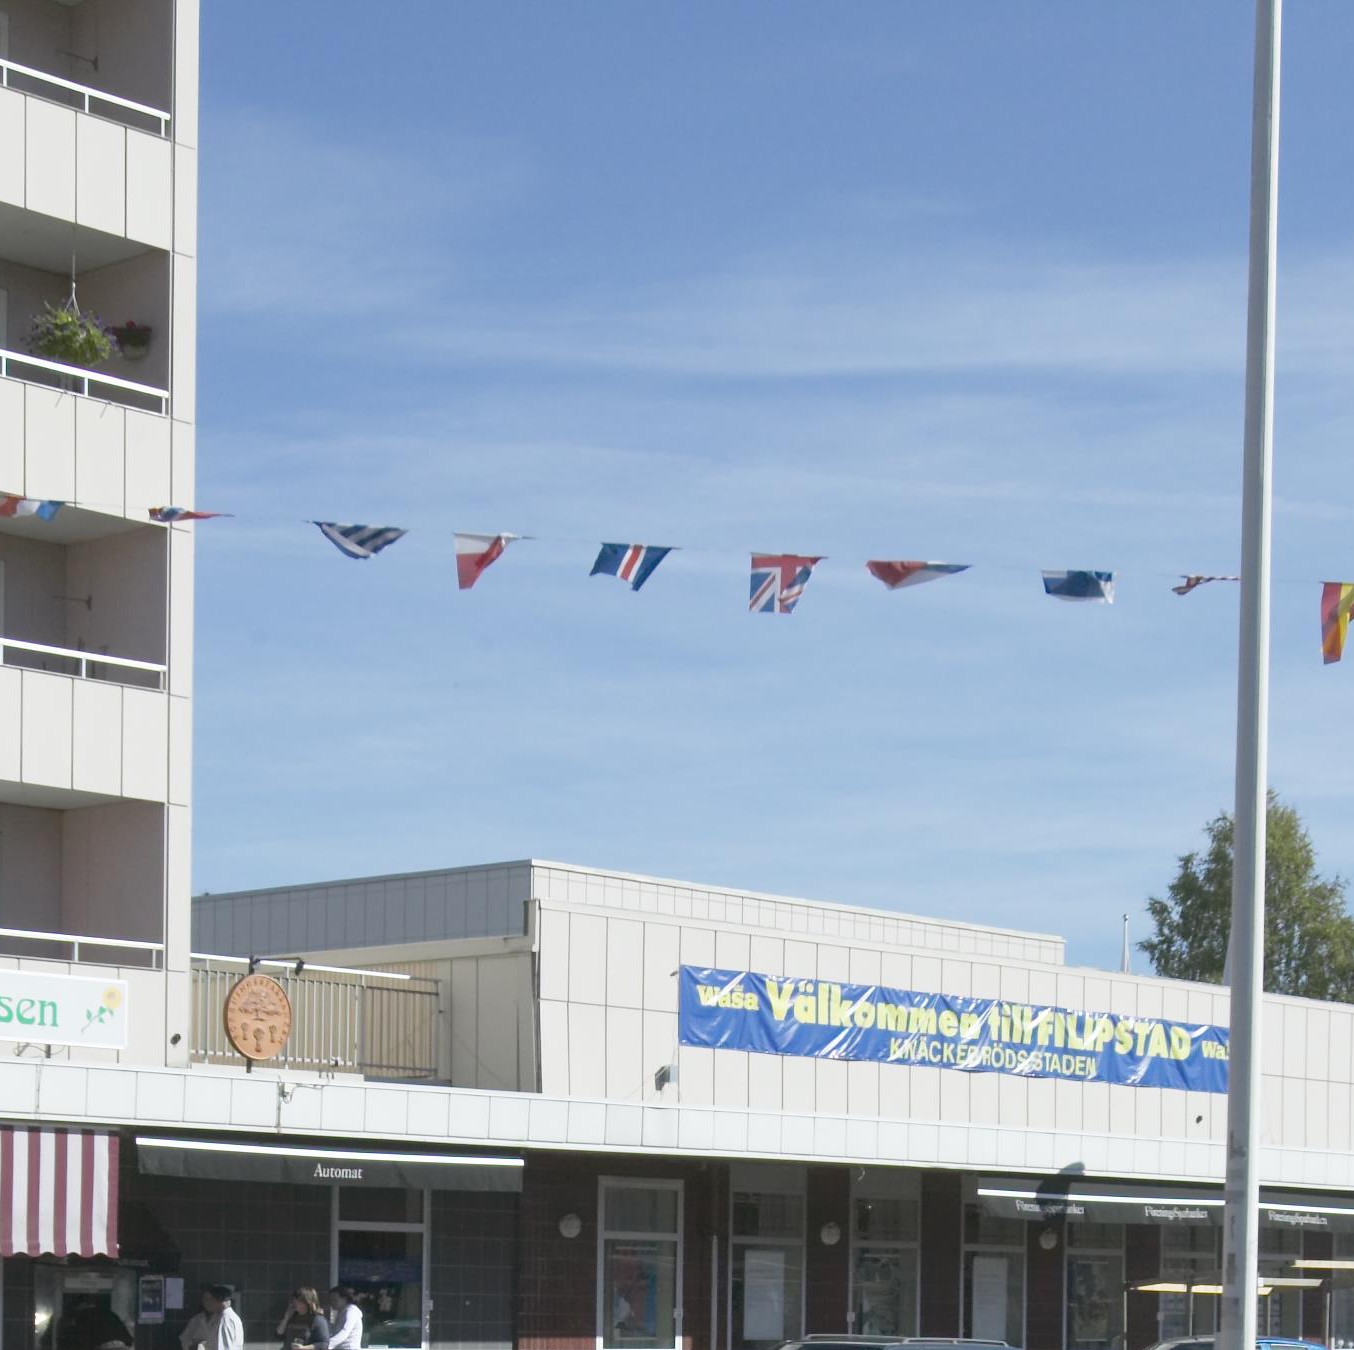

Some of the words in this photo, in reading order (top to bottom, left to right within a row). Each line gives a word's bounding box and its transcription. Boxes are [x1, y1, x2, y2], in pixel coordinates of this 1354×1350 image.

[765, 979, 981, 1040] Välkommen
[986, 1004, 1034, 1045] till
[1036, 1008, 1191, 1061] FILIPSTAD
[313, 1162, 363, 1179] Automat
